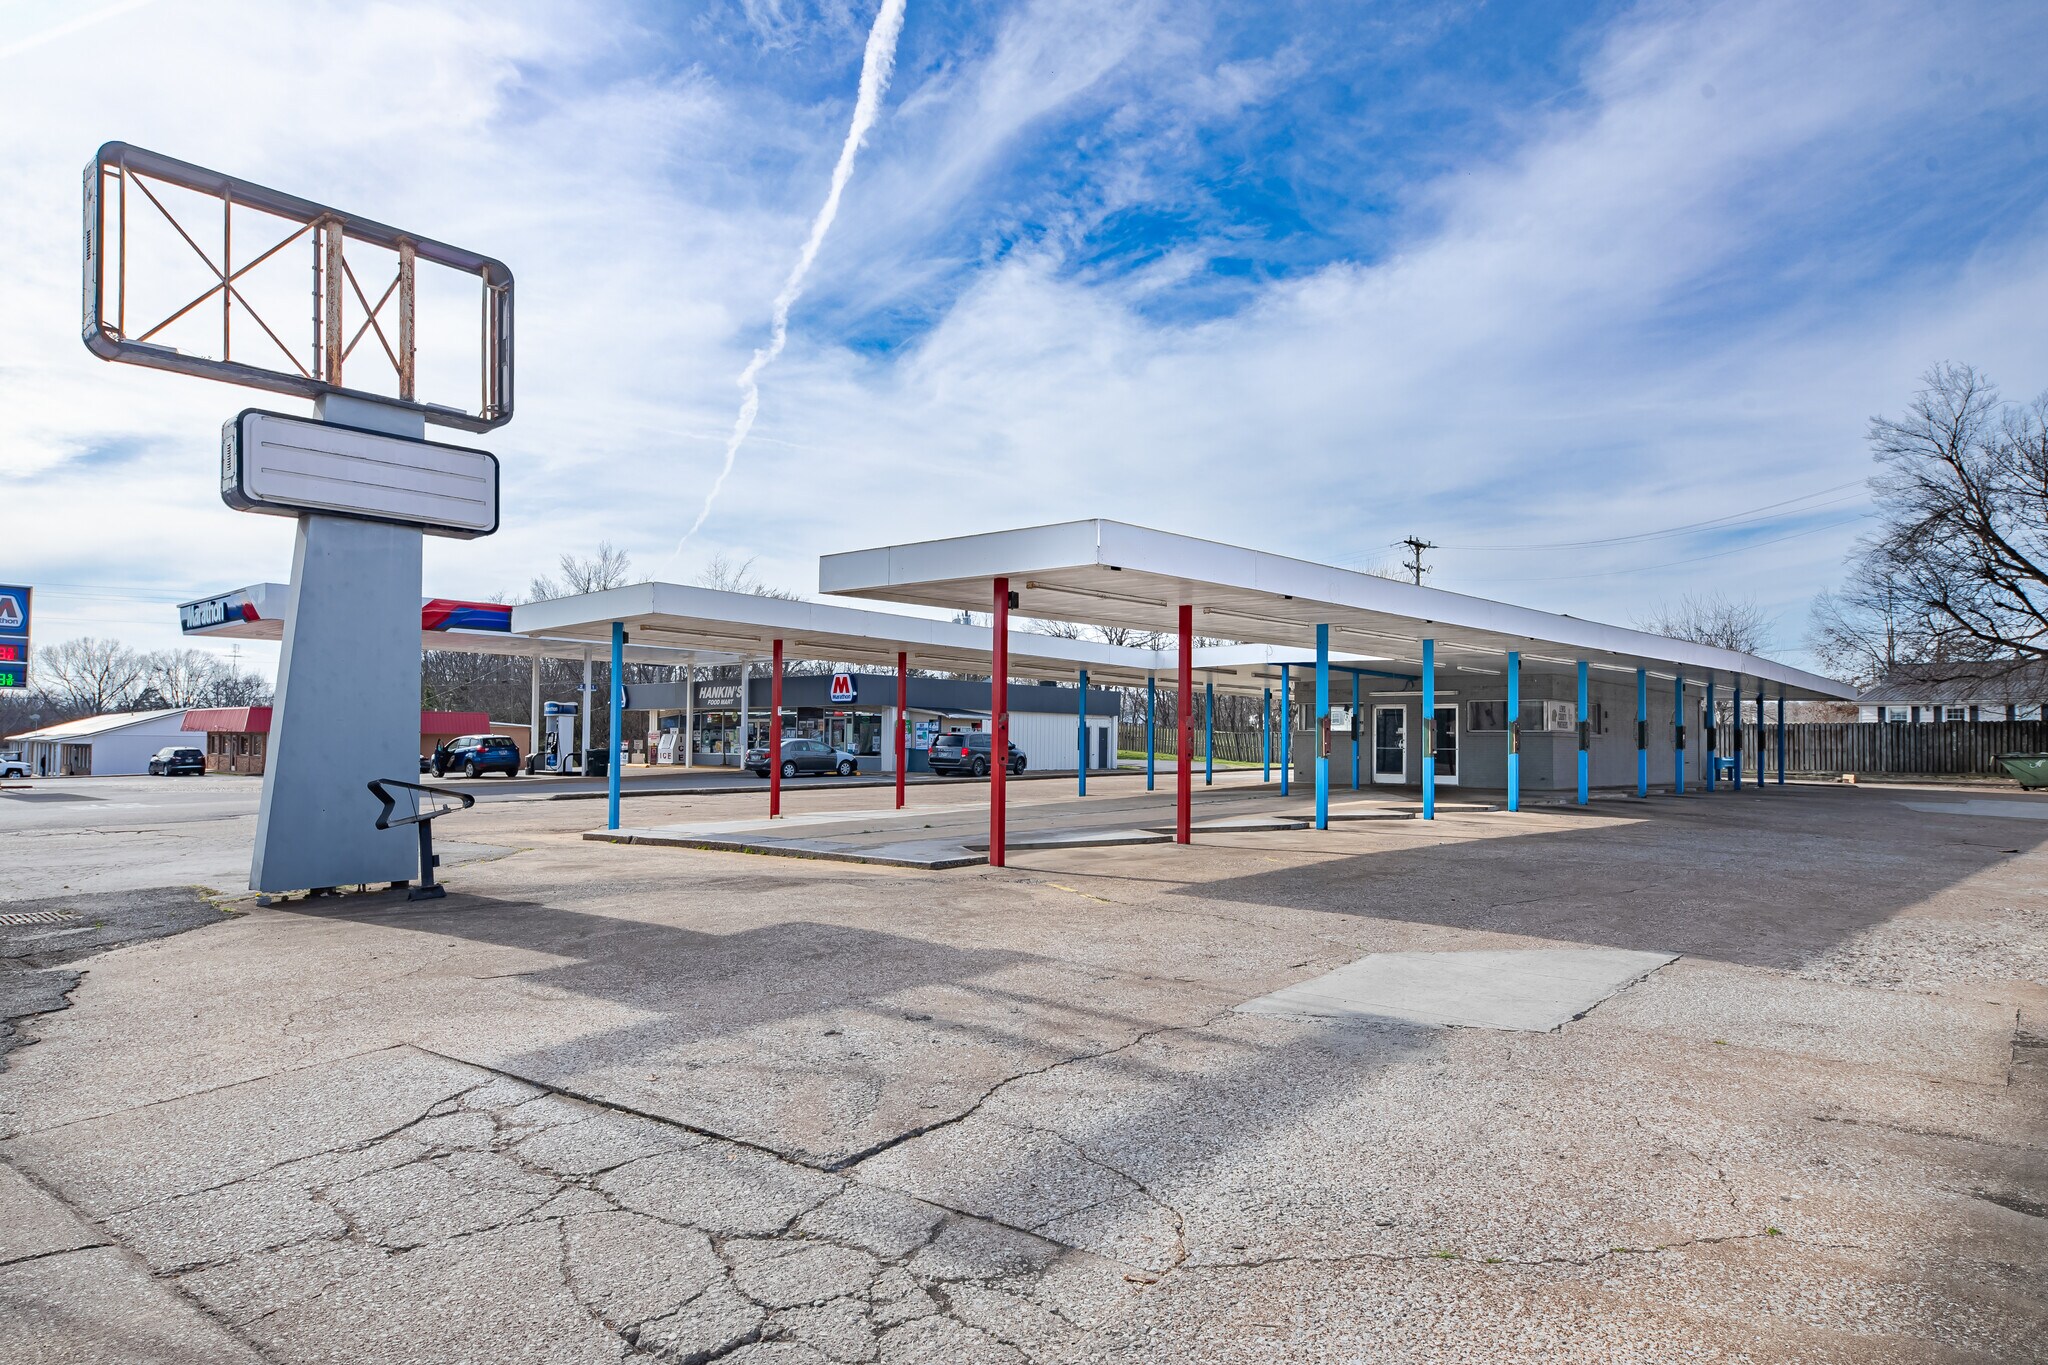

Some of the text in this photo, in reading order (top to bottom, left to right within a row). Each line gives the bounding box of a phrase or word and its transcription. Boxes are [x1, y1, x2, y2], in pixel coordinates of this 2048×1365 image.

[187, 601, 224, 628] Marathon
[698, 685, 743, 699] HANKIN'S
[833, 676, 850, 694] M
[659, 752, 672, 760] ICE
[677, 736, 685, 762] ICE
